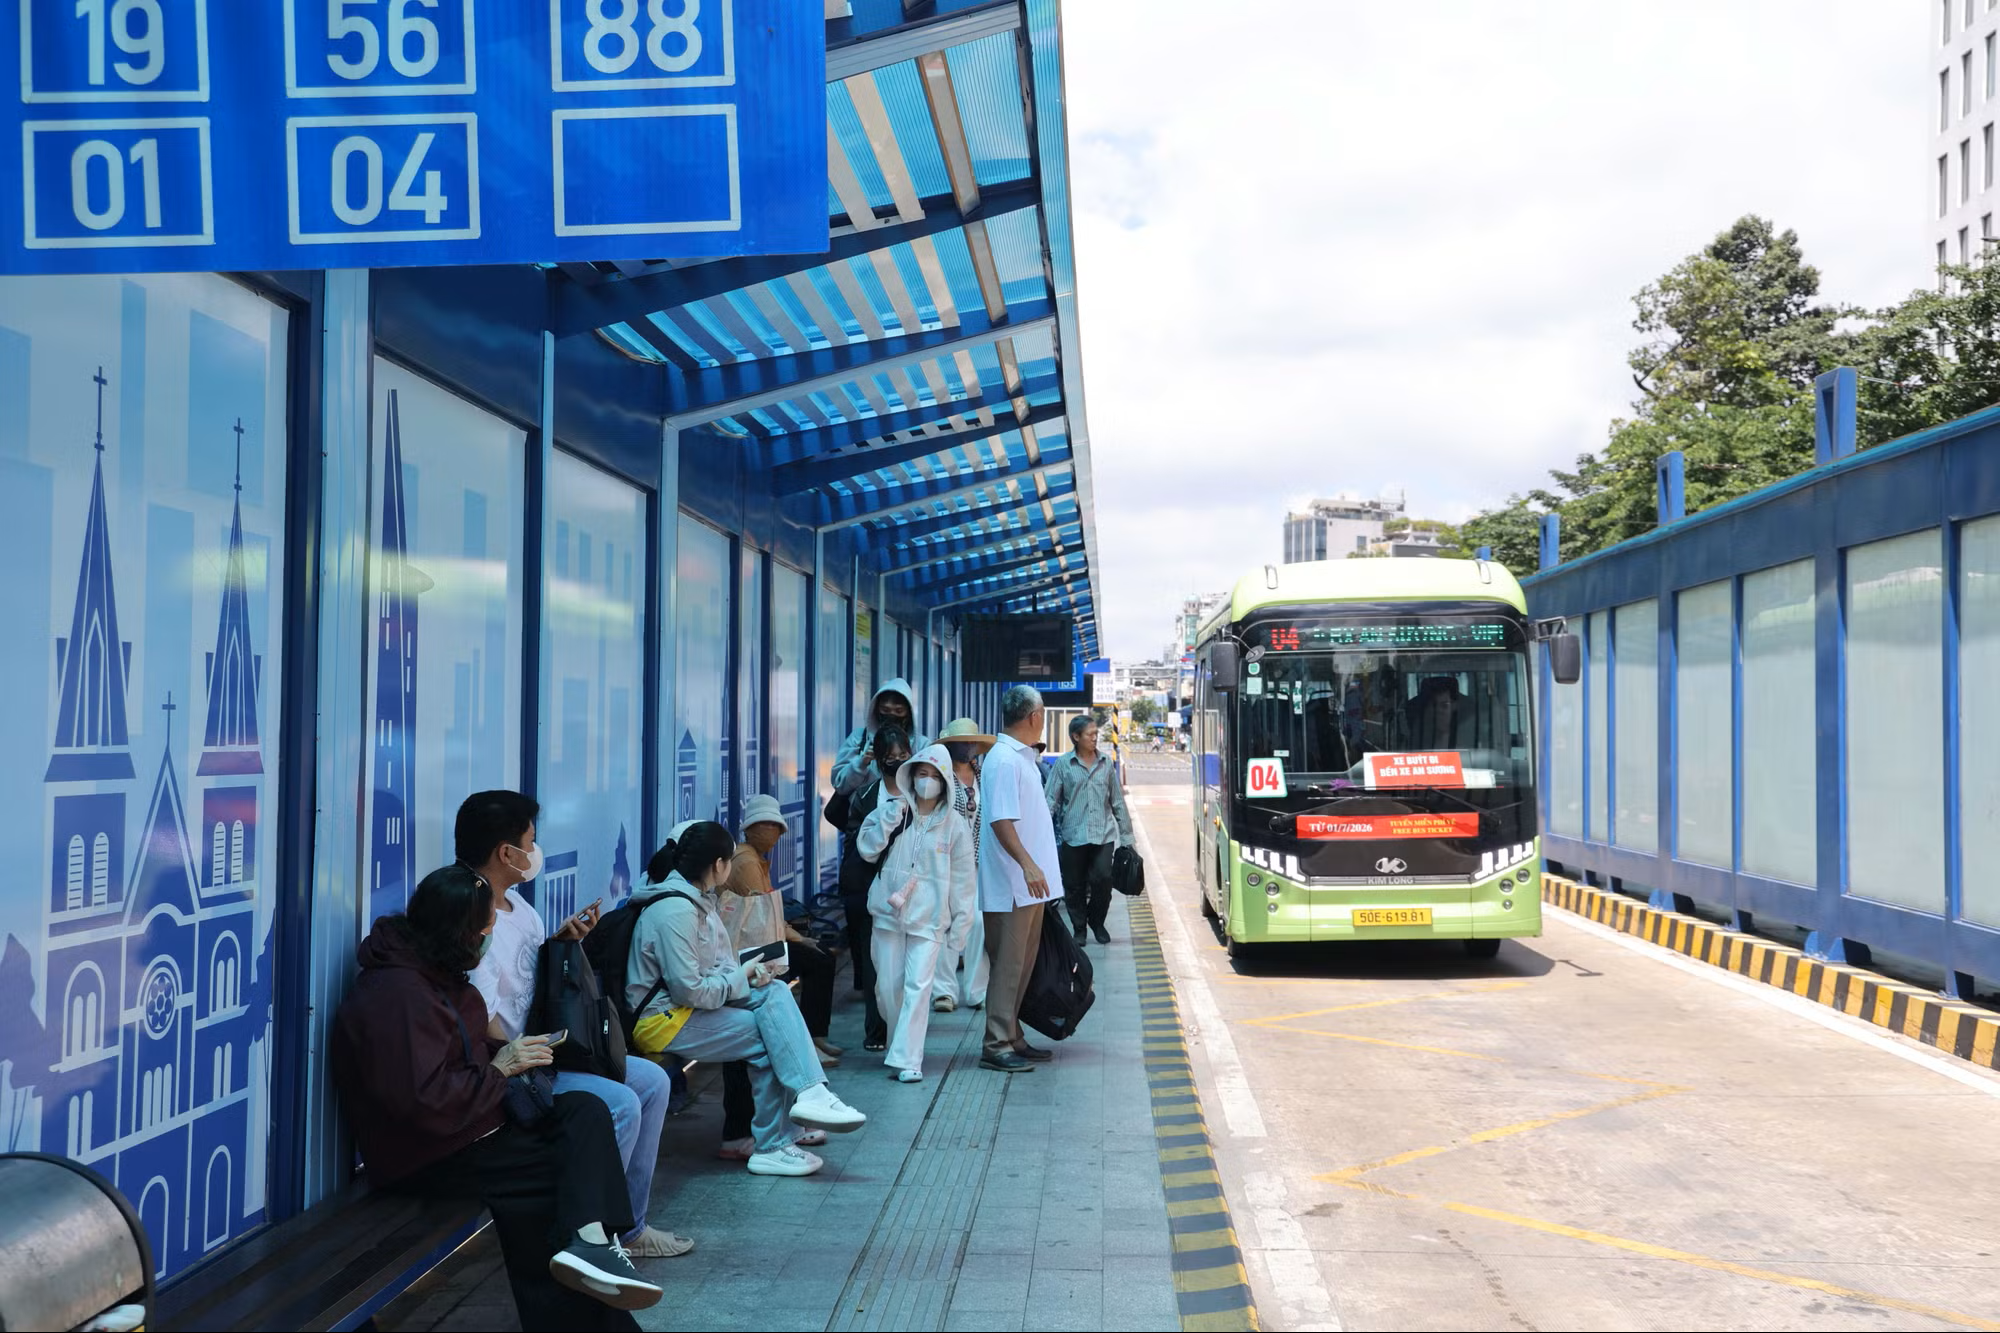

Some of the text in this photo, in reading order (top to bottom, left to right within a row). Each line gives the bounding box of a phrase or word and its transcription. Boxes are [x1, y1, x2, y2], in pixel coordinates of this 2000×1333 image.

[75, 0, 702, 86] 19 56 88
[70, 133, 448, 231] 01 04
[1399, 767, 1411, 776] XE
[1412, 766, 1425, 775] AN
[1251, 765, 1279, 791] 04
[1327, 823, 1373, 833] 01/7/2026
[1367, 876, 1414, 884] KIM LONG
[1359, 911, 1424, 923] 50E-619.81
